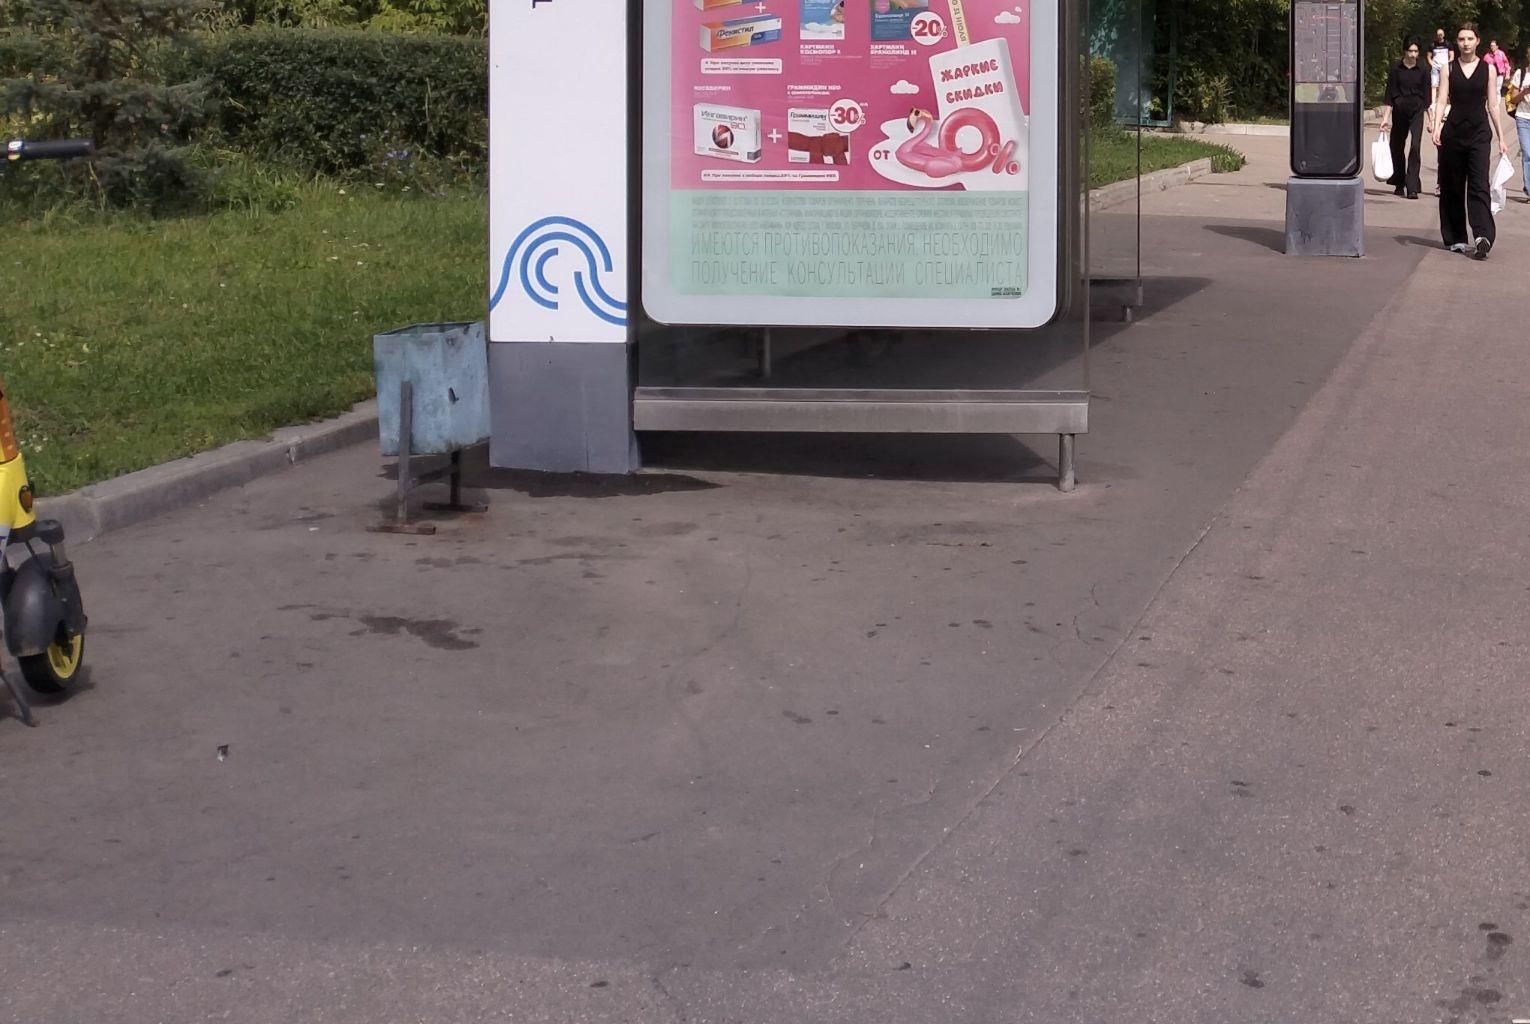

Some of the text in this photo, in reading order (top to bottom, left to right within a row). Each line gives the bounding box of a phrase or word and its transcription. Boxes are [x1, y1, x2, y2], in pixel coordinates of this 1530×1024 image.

[940, 59, 999, 82] ЖАРКИЕ
[946, 81, 1004, 104] СКИДКИ
[691, 231, 760, 256] ИМЕЮТСЯ
[923, 232, 1023, 259] НЕОБХОДИМО
[691, 260, 1022, 286] ПОЛУЧЕНИЕ КОНСУЛЬТАЦИИ СПЕЦИАЛИСТА
